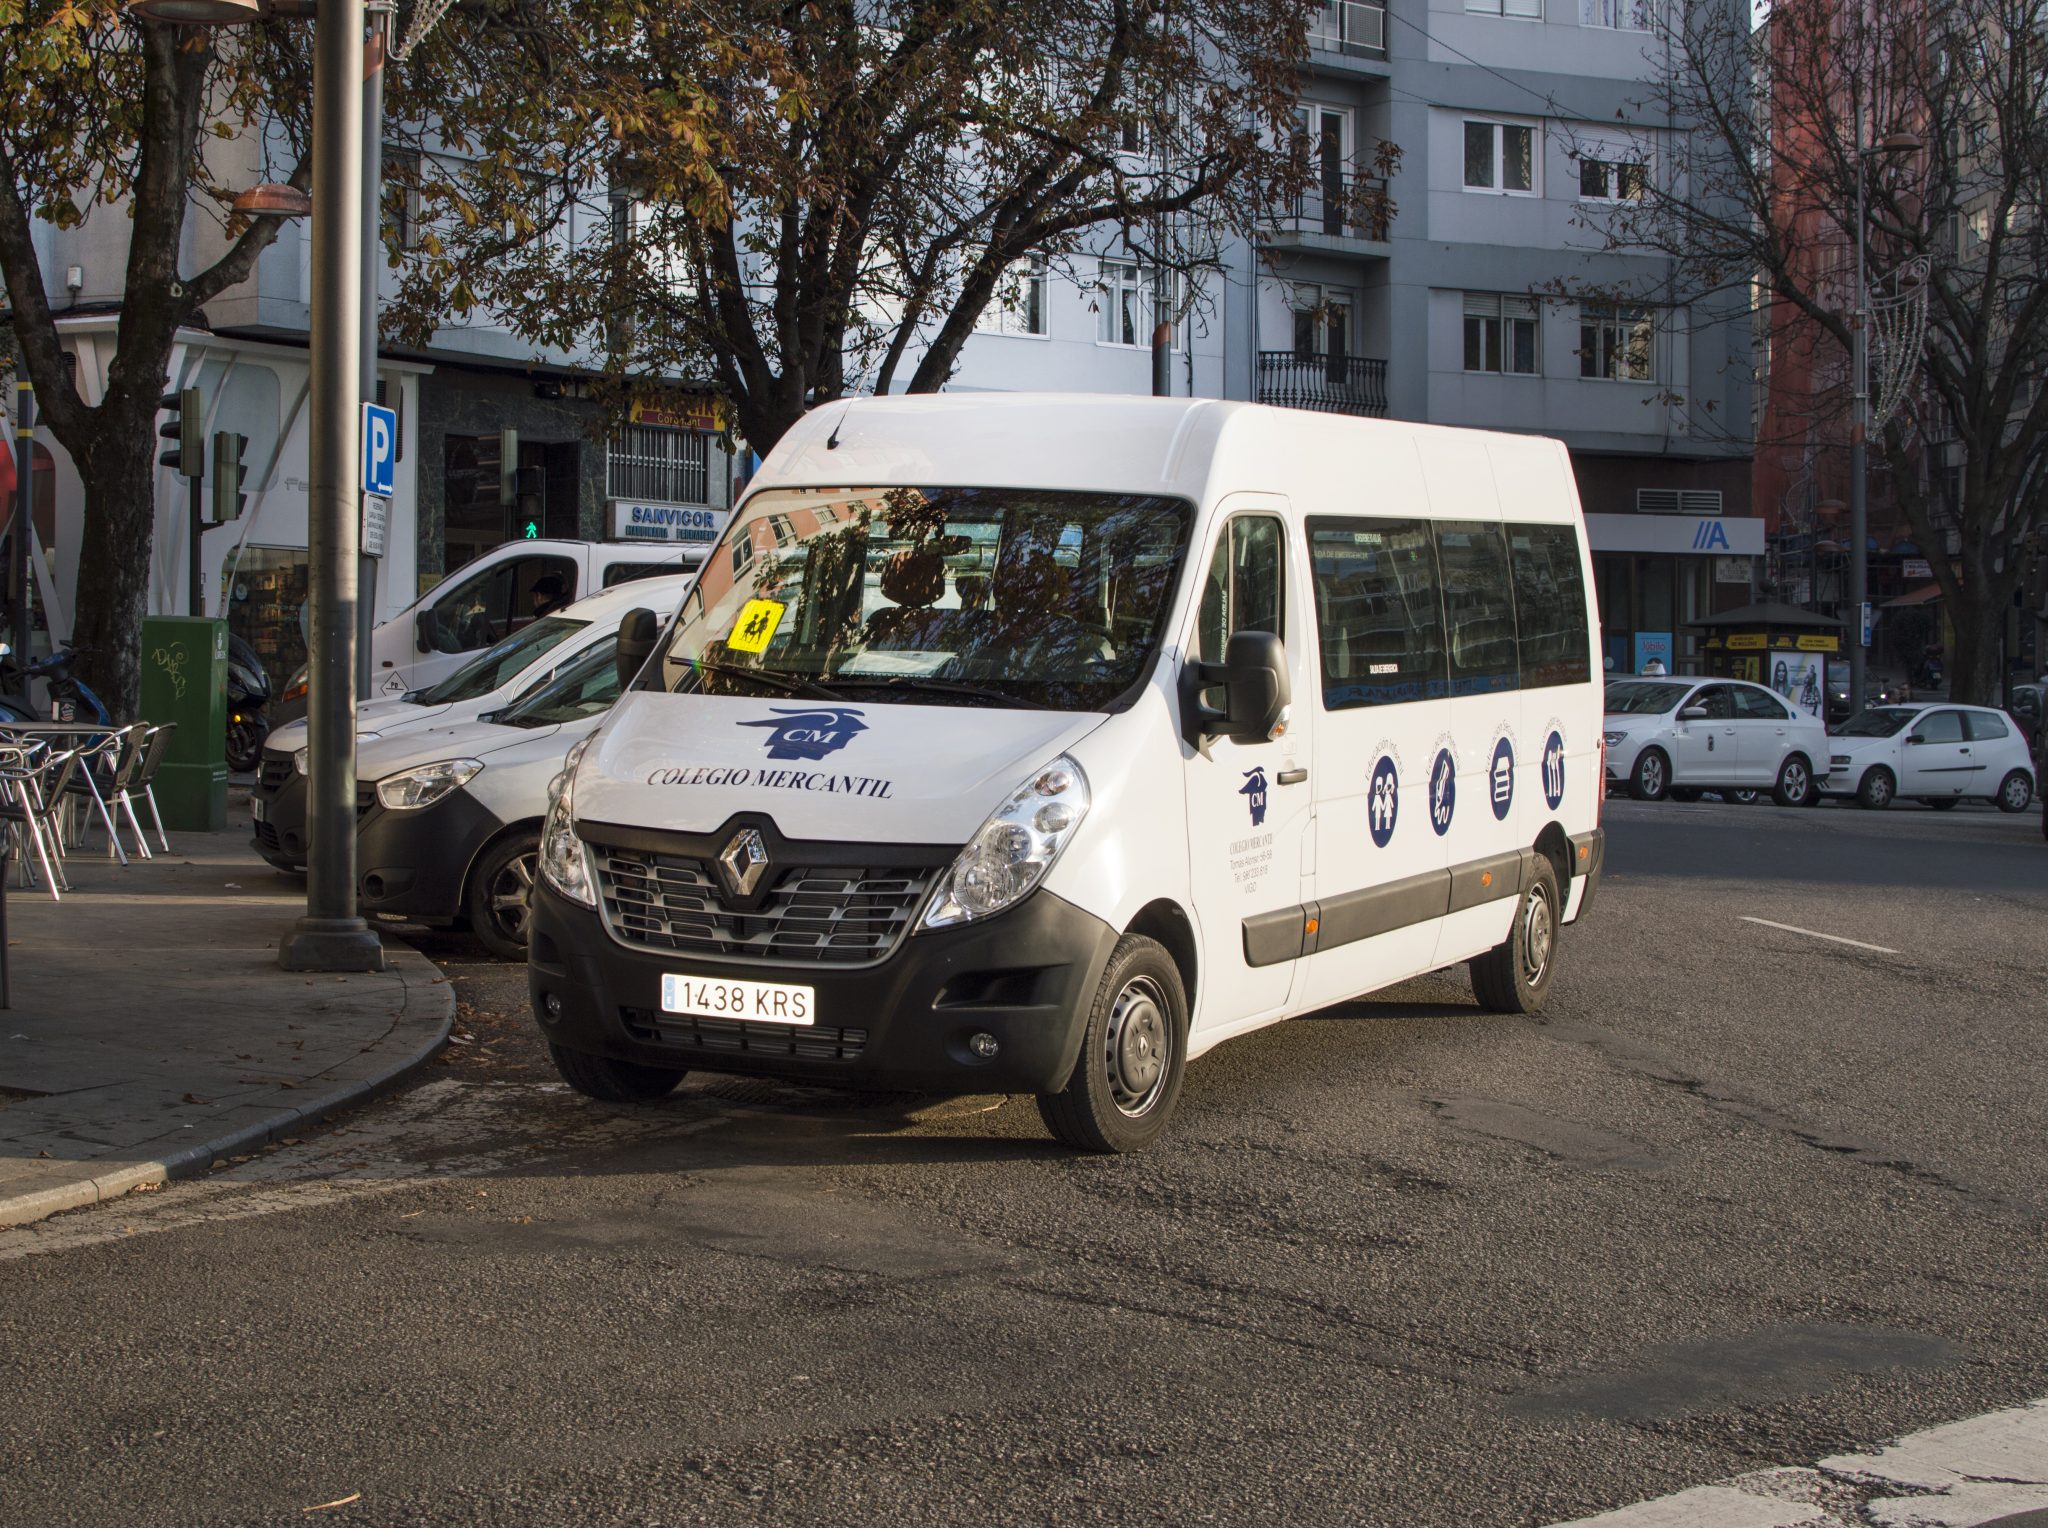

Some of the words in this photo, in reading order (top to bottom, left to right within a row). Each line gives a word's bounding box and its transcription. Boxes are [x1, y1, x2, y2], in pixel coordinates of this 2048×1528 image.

[371, 416, 389, 483] P
[632, 506, 715, 528] SANVICOR
[783, 728, 839, 744] CM
[647, 768, 750, 786] COLEGIO
[751, 769, 895, 799] MERCANTIL
[1251, 791, 1264, 808] CM
[684, 982, 744, 1013] 1438
[756, 988, 806, 1018] KRS
